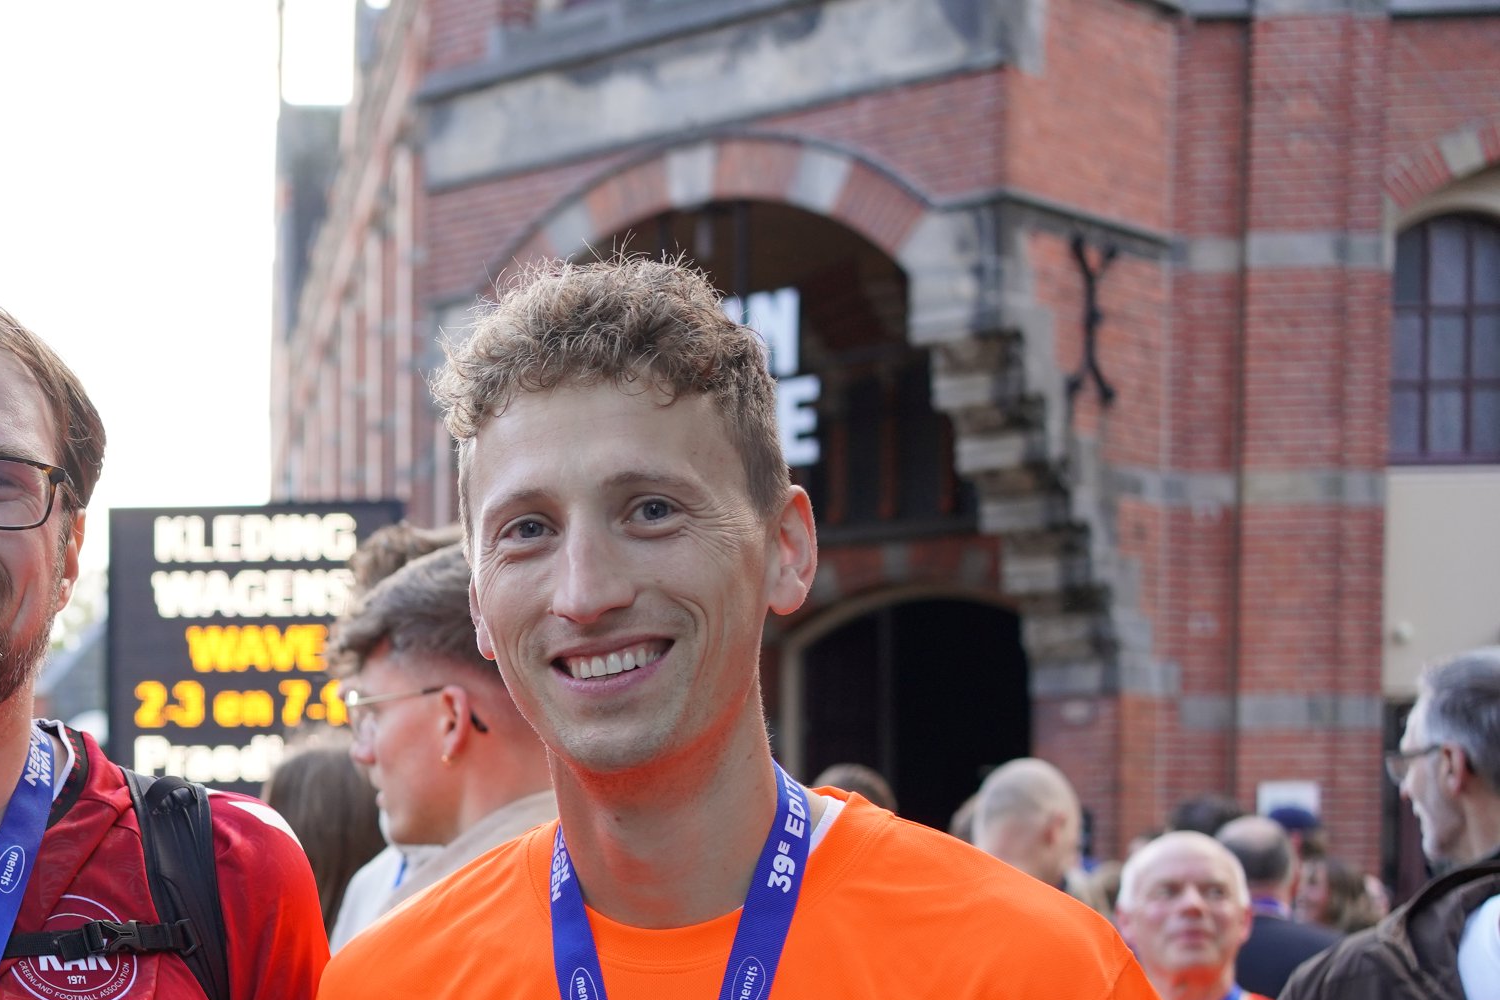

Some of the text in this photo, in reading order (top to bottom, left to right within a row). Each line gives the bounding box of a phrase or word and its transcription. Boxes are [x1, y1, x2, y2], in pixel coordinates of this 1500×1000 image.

[154, 513, 357, 563] KLEDING
[185, 624, 329, 673] WAVE
[134, 680, 205, 728] 2-3
[213, 690, 274, 727] en
[0, 851, 19, 886] menzis
[767, 840, 796, 893] 39E
[18, 960, 129, 1000] GREENLAND FOOTBALL ASSOCIATION
[67, 975, 87, 985] 1971
